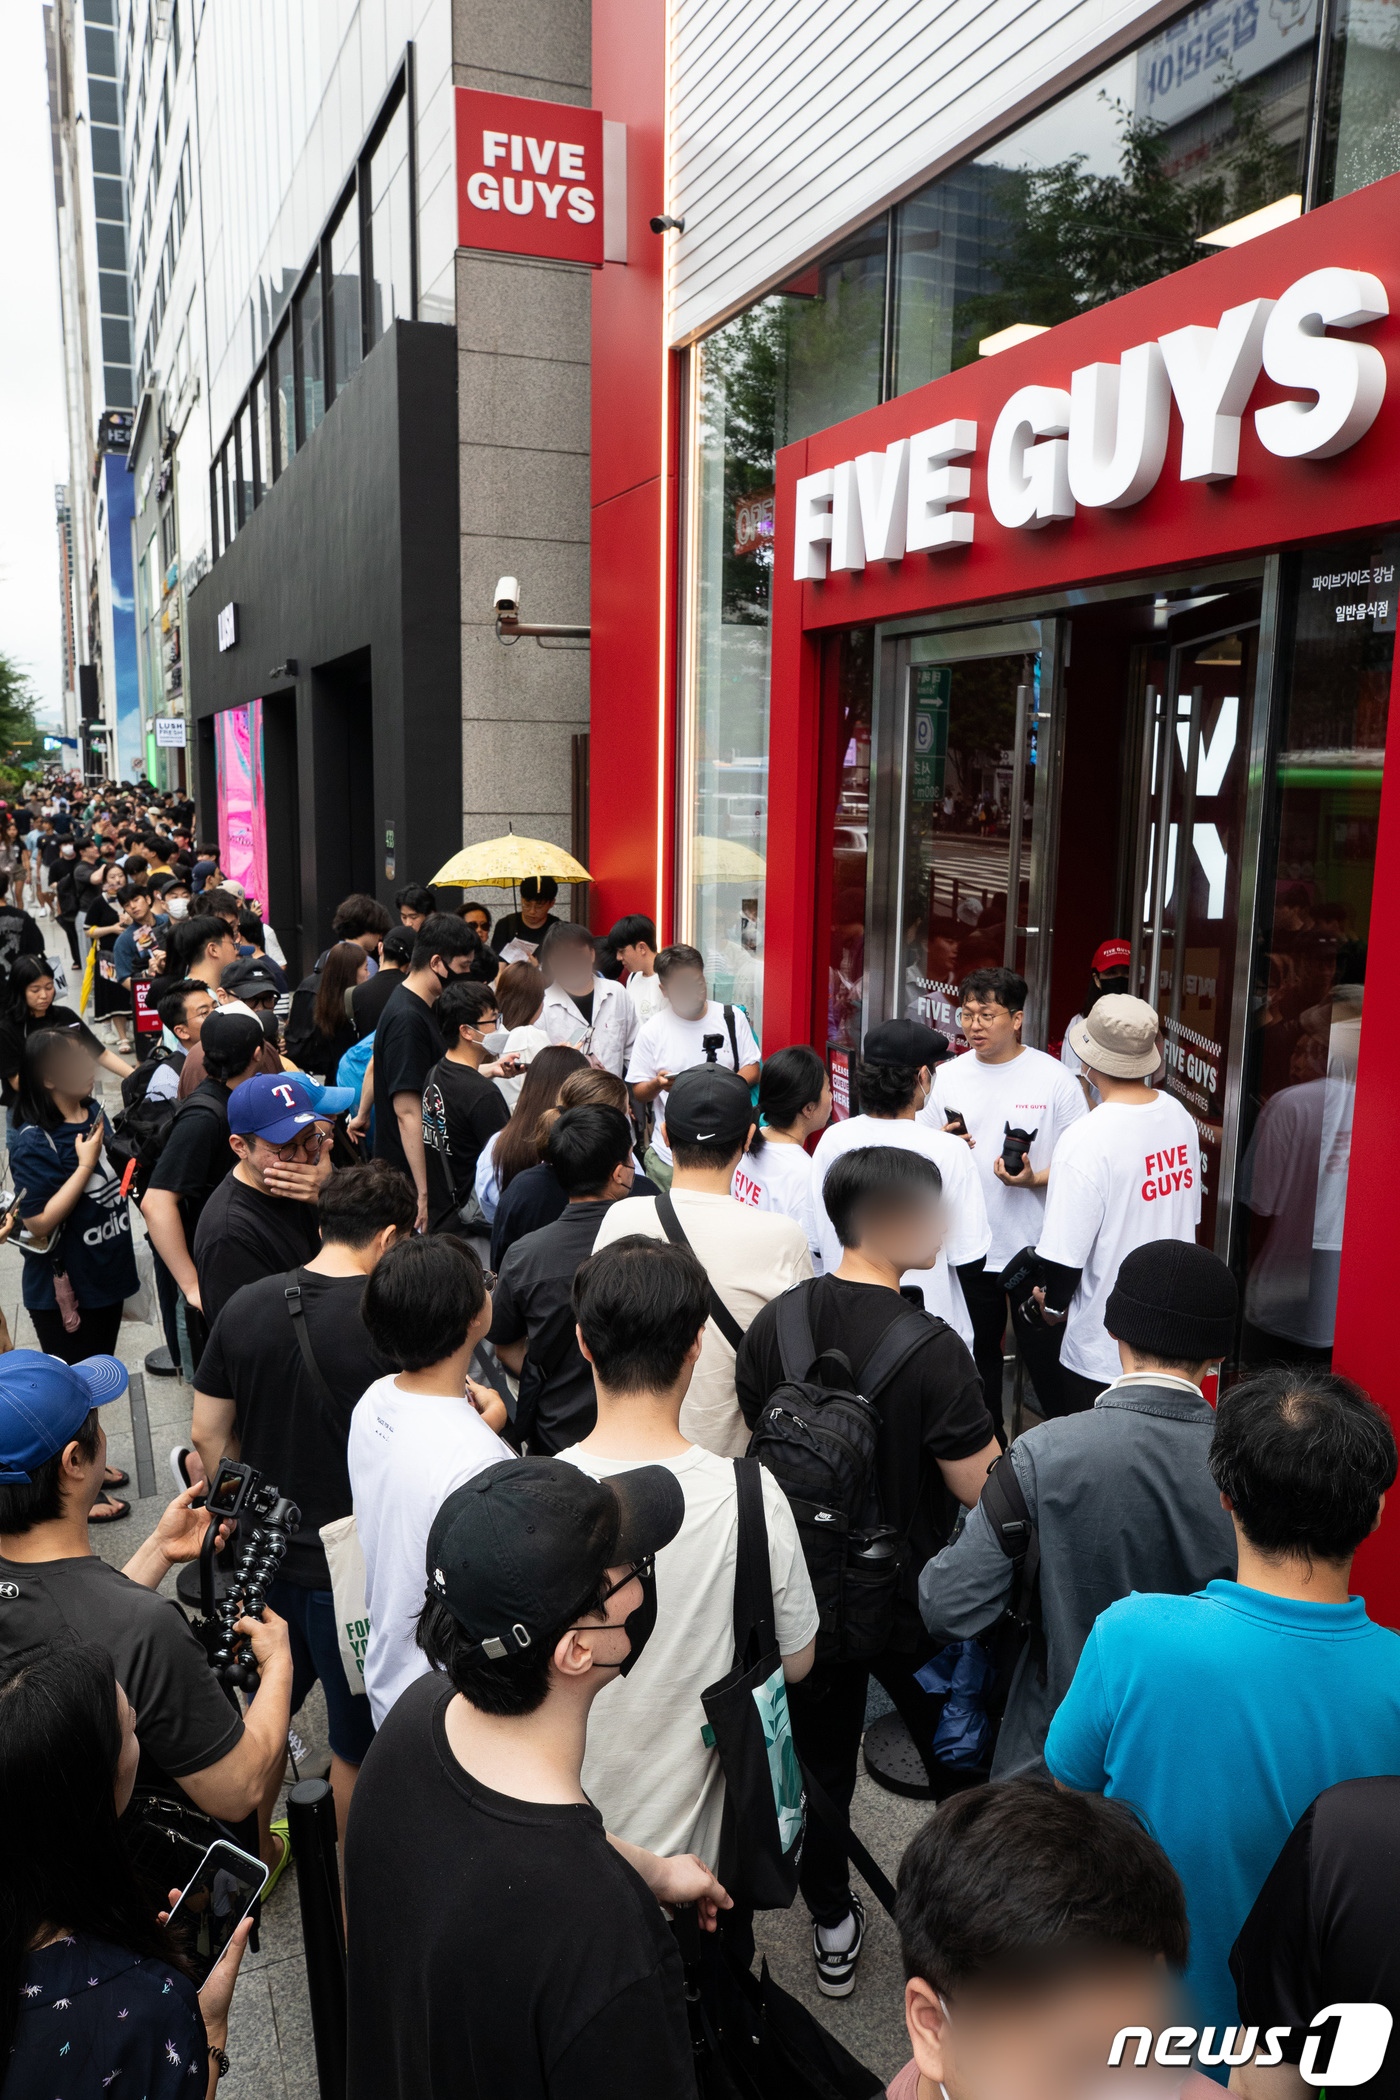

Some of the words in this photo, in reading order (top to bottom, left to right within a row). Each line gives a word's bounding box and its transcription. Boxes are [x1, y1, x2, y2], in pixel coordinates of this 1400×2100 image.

[482, 130, 585, 181] FIVE
[467, 172, 596, 224] GUYS
[793, 418, 977, 582] FIVE
[987, 267, 1390, 530] GUYS
[1312, 569, 1371, 591] 파이브가이즈
[1373, 565, 1395, 584] 강남
[1335, 600, 1389, 622] 일반음식점
[917, 996, 951, 1024] FIVE
[1163, 1039, 1186, 1073] FIVE
[1186, 1053, 1217, 1094] GUYS
[271, 1083, 296, 1109] T
[833, 1089, 850, 1109] HERE
[1166, 1073, 1187, 1098] BURGERS
[1186, 1090, 1195, 1103] and
[1194, 1091, 1209, 1112] FRIES
[1144, 1144, 1188, 1177] FIVE
[735, 1169, 762, 1206] FIVE
[1141, 1168, 1193, 1202] GUYS
